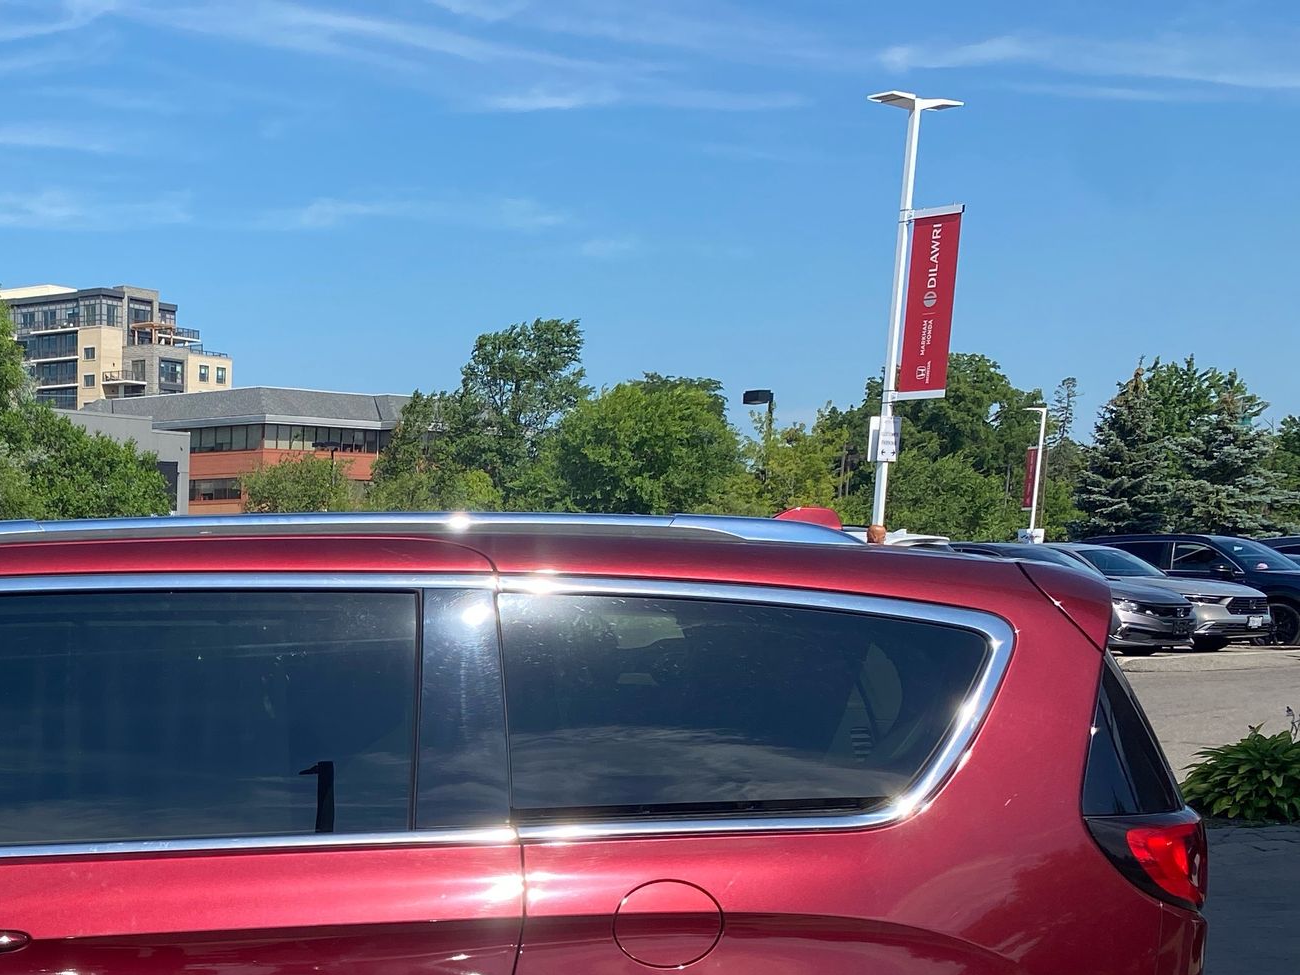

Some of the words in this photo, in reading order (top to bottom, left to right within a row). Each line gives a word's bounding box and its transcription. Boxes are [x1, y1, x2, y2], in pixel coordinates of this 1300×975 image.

[927, 223, 942, 289] DILAWRI
[920, 319, 928, 356] MARKHAM
[926, 319, 934, 345] HONDA
